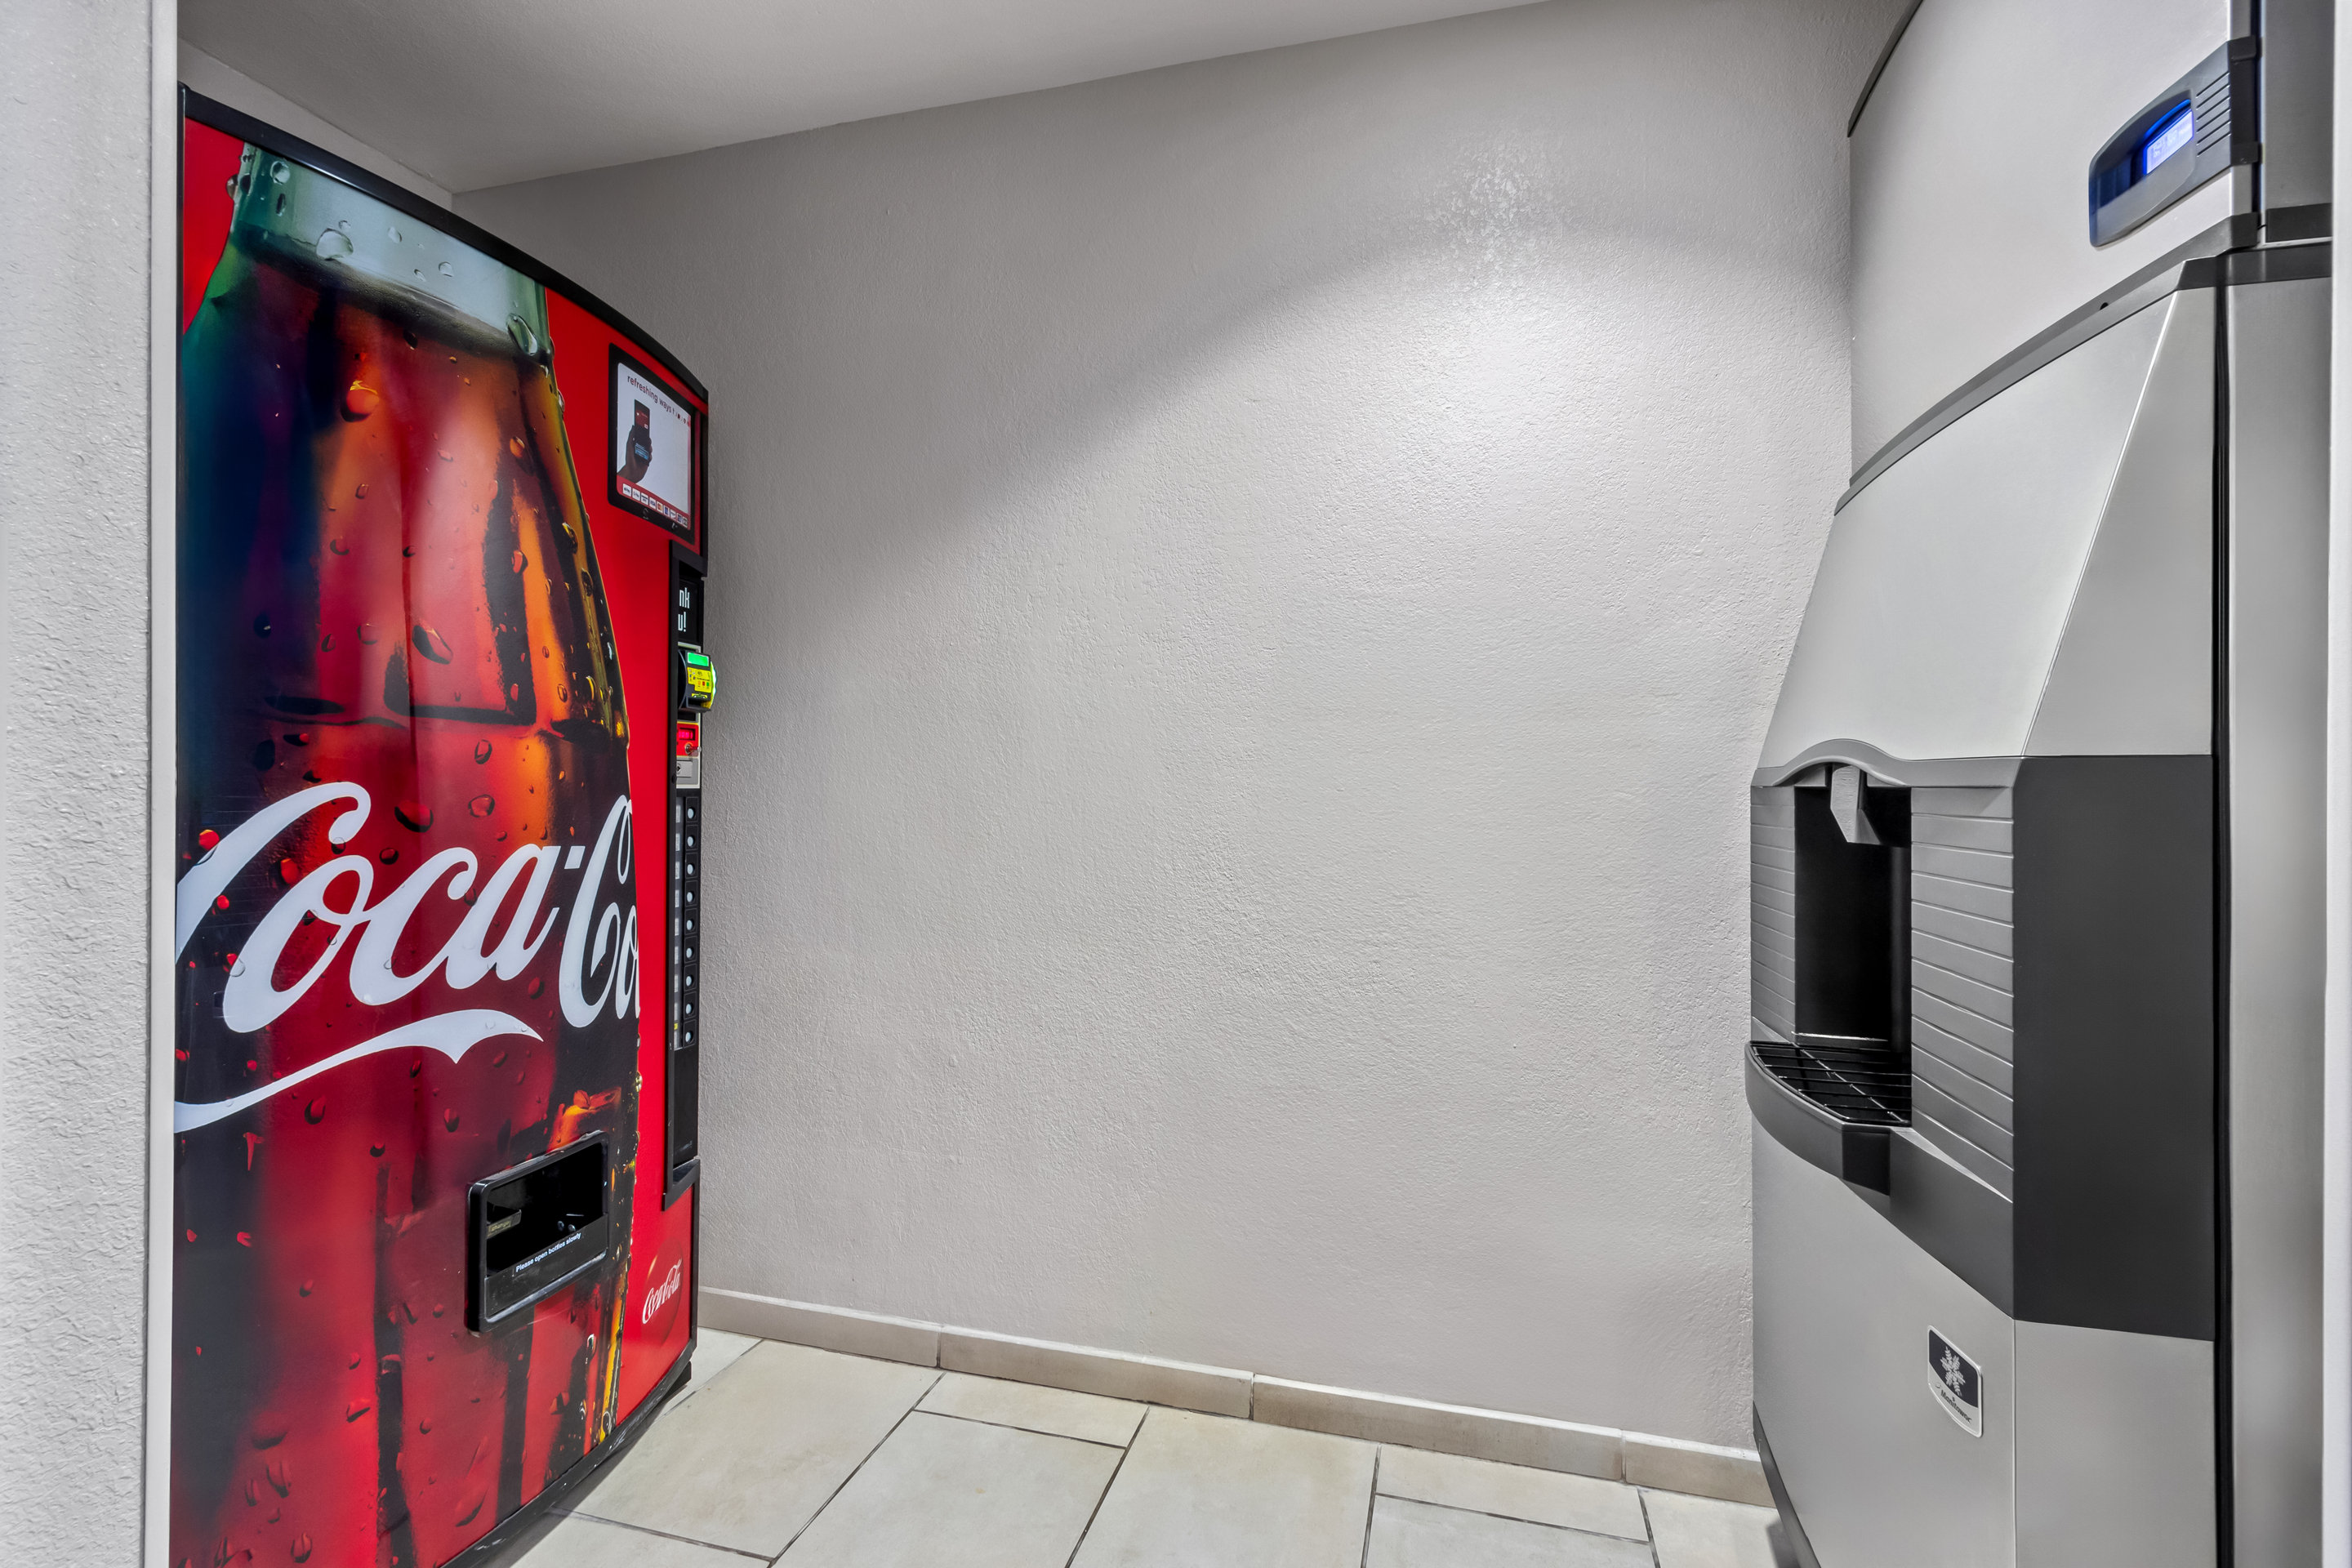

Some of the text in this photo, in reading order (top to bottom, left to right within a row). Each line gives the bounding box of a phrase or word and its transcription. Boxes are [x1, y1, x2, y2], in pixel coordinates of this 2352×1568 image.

[628, 376, 657, 403] refreshing
[515, 1232, 581, 1272] Please open bottles slowly
[1940, 1389, 1972, 1423] Manitowoc
